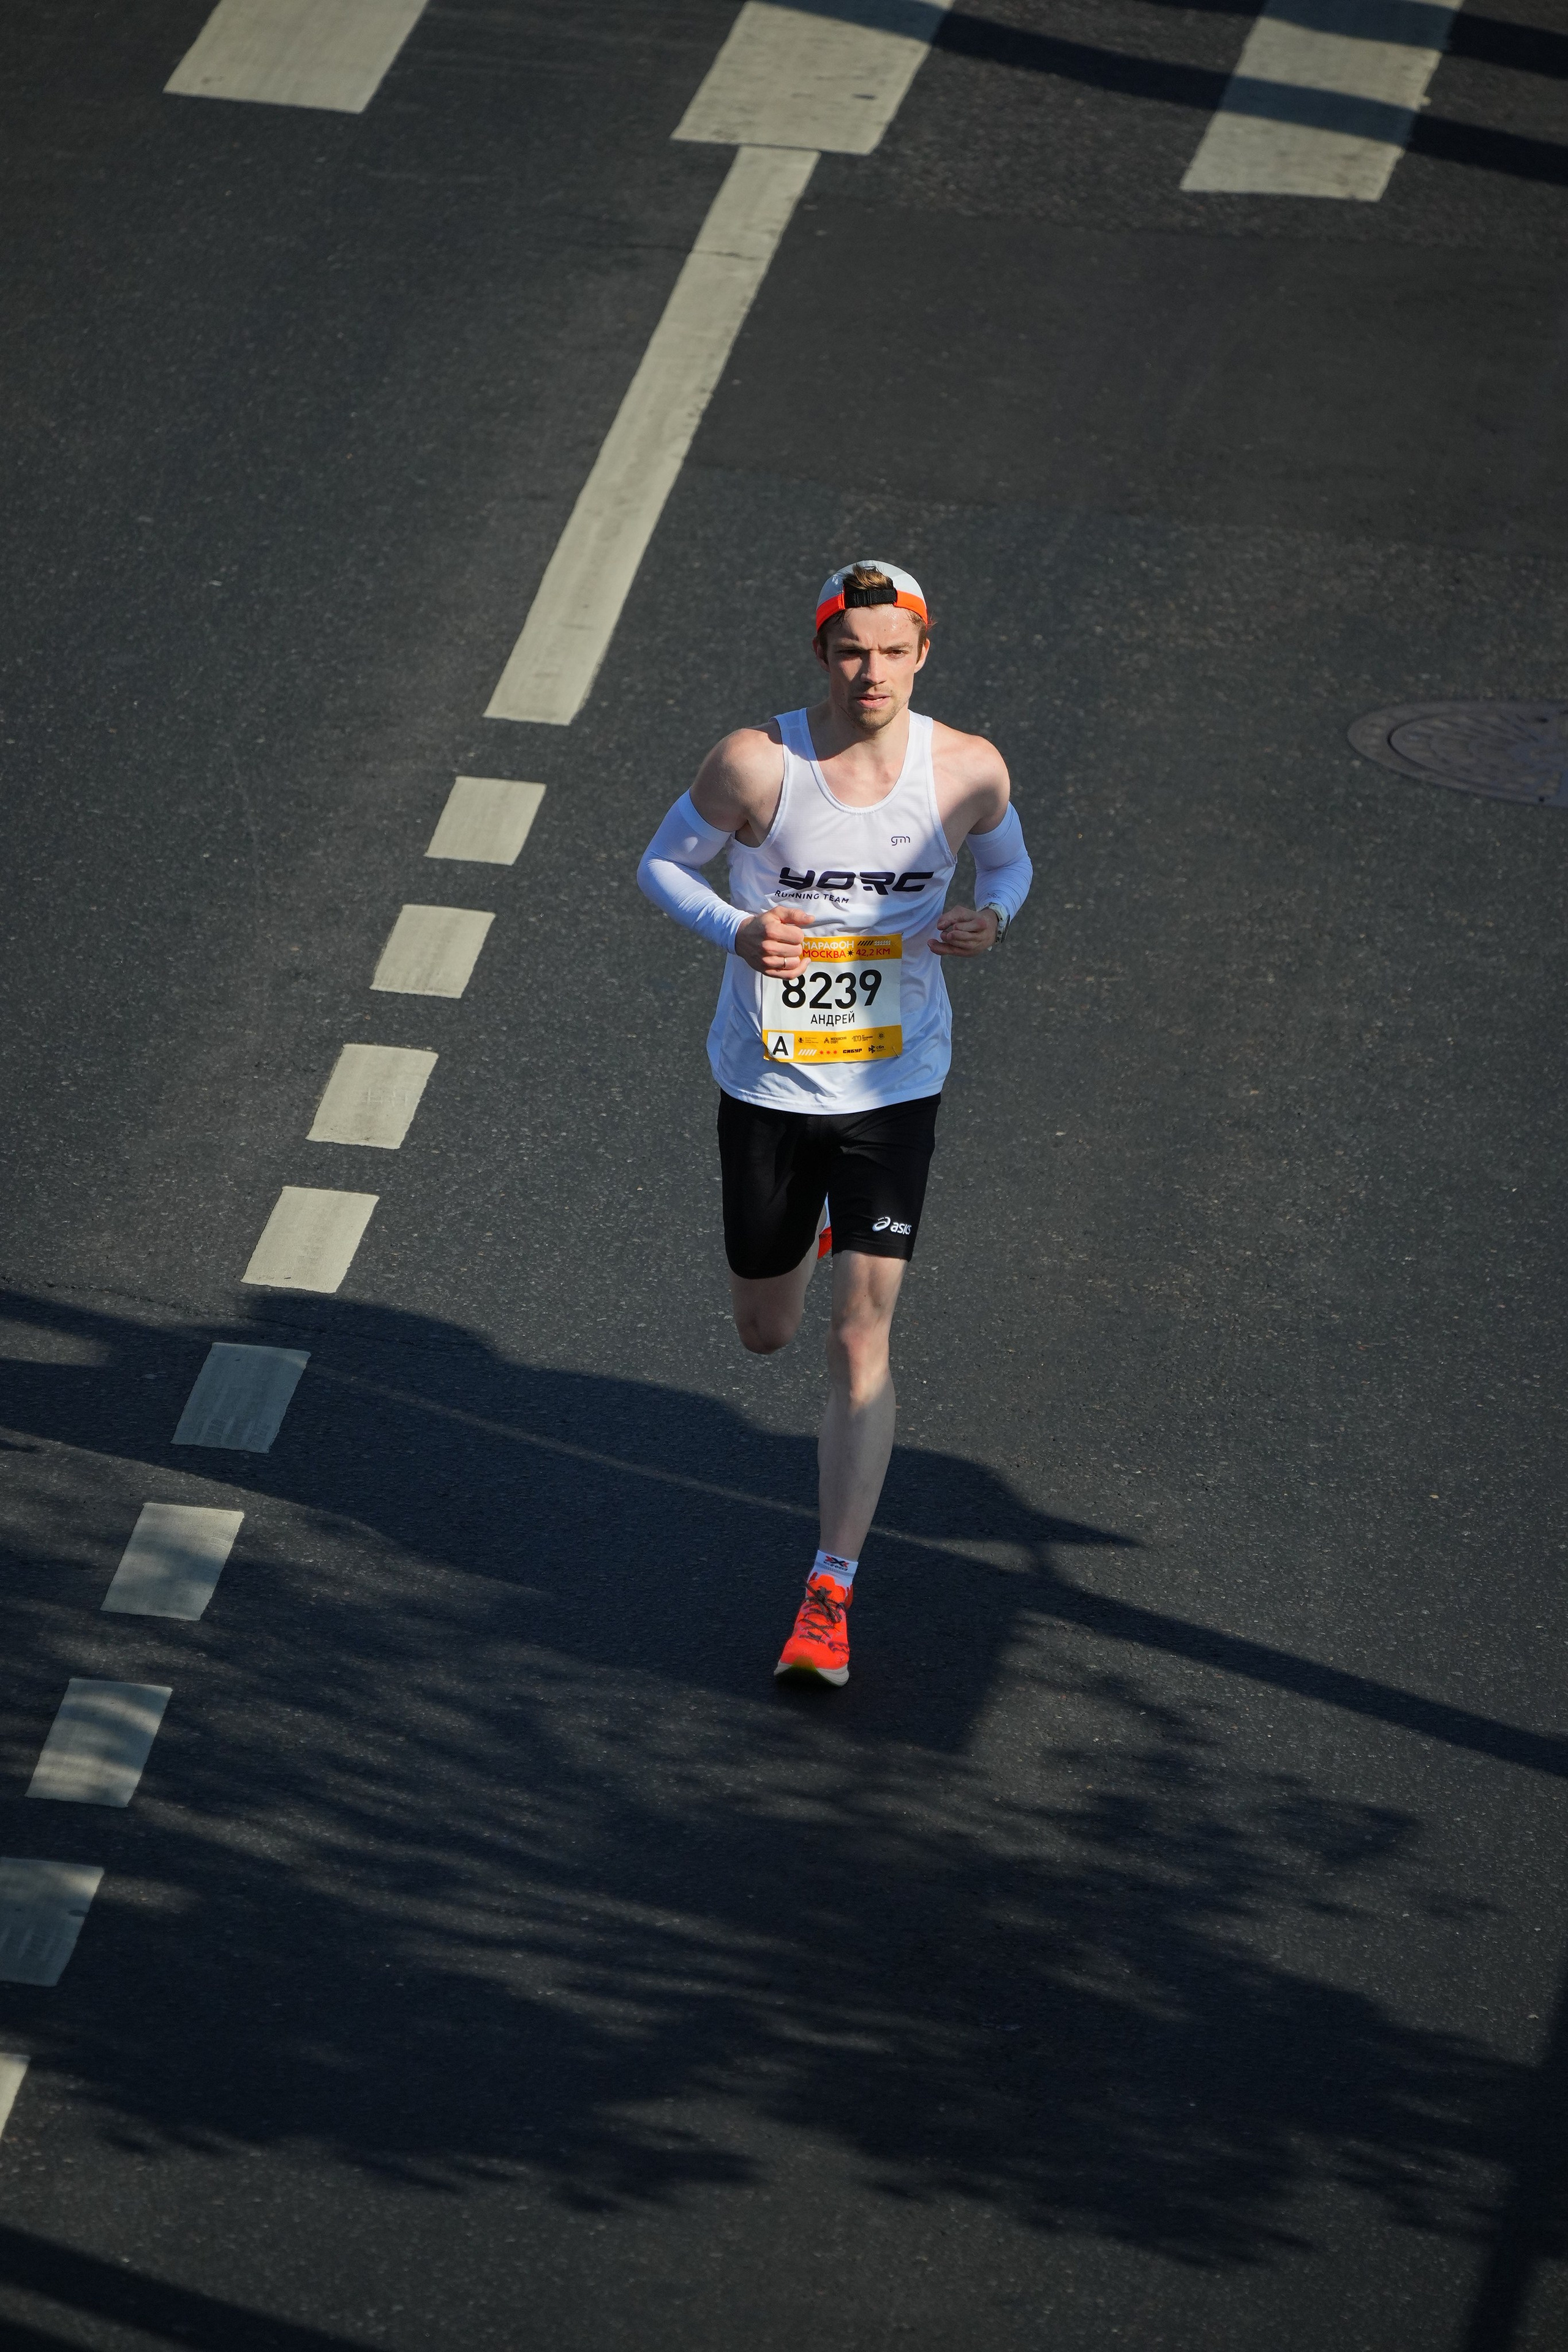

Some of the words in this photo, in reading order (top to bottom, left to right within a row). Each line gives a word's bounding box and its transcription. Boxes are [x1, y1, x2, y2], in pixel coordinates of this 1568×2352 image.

[778, 867, 935, 895] YORC
[774, 889, 820, 900] RUNNING
[823, 894, 850, 904] TEAM
[802, 940, 854, 950] МАРАФОН
[802, 949, 846, 959] МОСКВА
[856, 948, 875, 957] 42,2
[782, 969, 883, 1009] 8239
[810, 1011, 855, 1027] АНДРЕЙ
